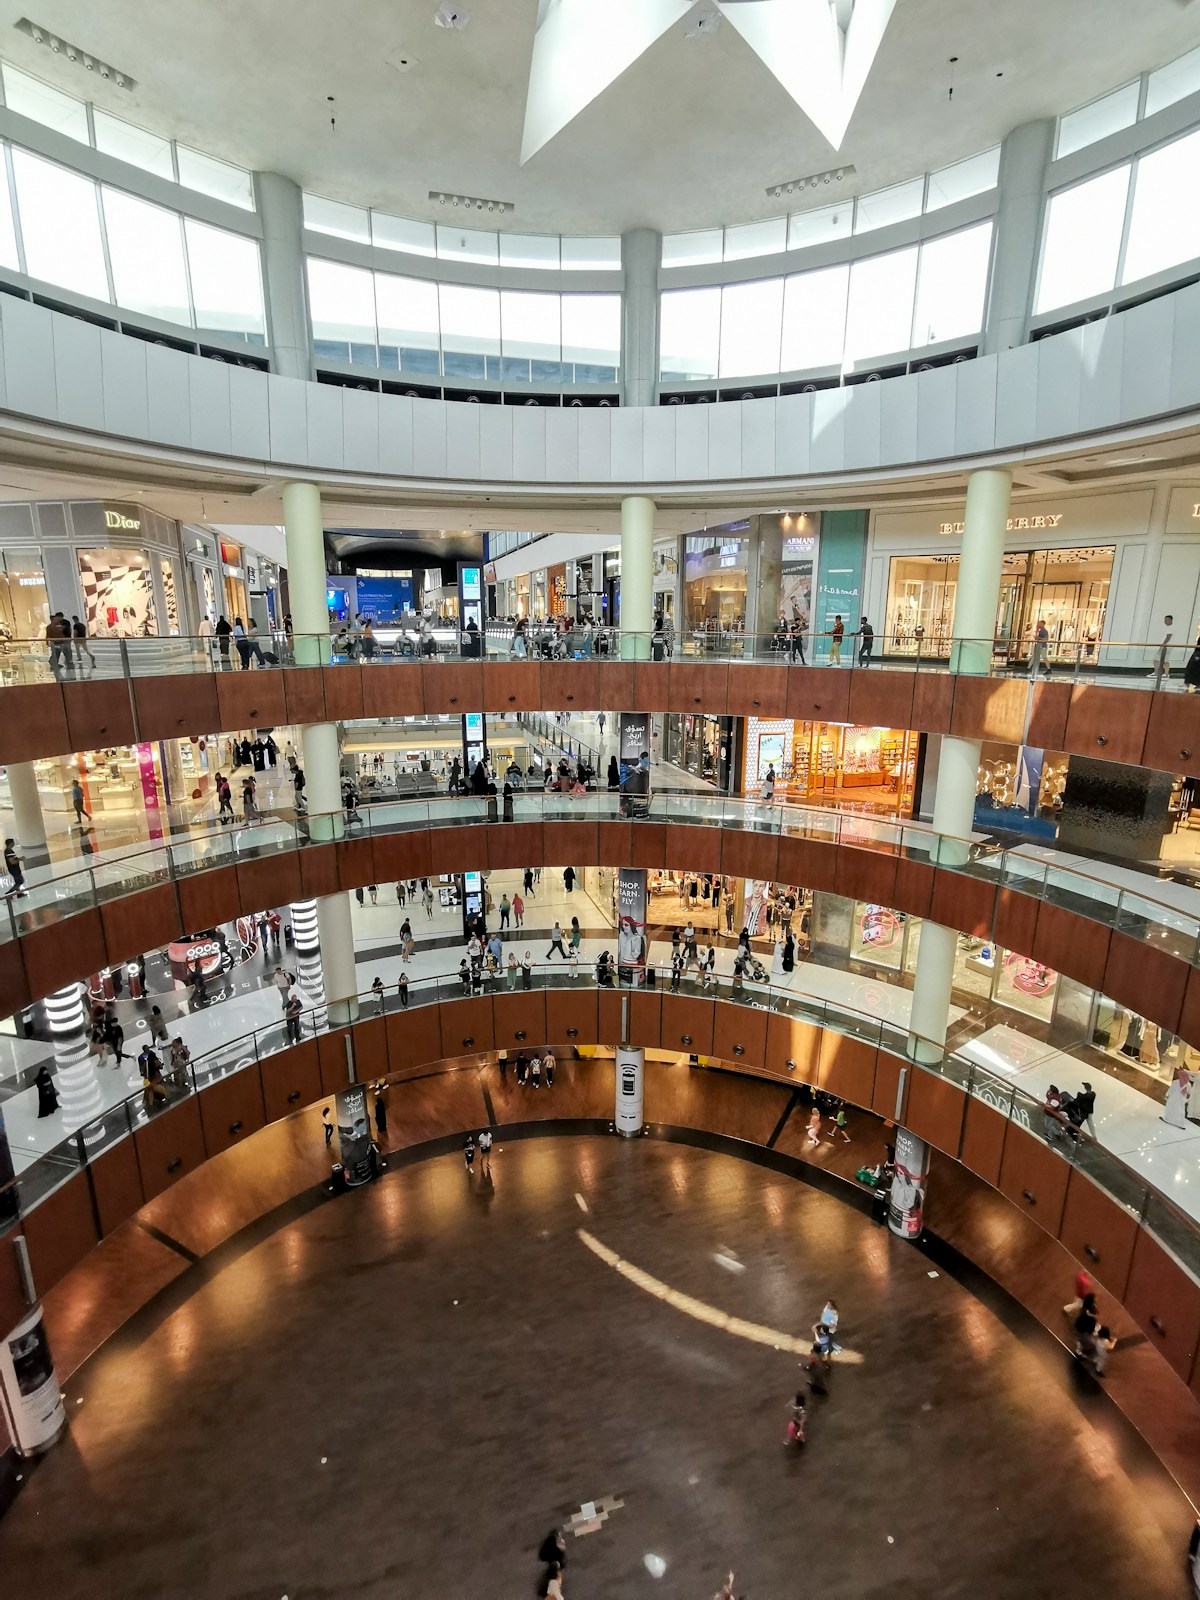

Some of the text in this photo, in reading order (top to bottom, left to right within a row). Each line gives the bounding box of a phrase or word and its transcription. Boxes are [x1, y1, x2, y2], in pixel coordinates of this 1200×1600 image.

[104, 511, 140, 529] Dior
[787, 537, 815, 545] ARMANI
[622, 897, 635, 905] FLY.
